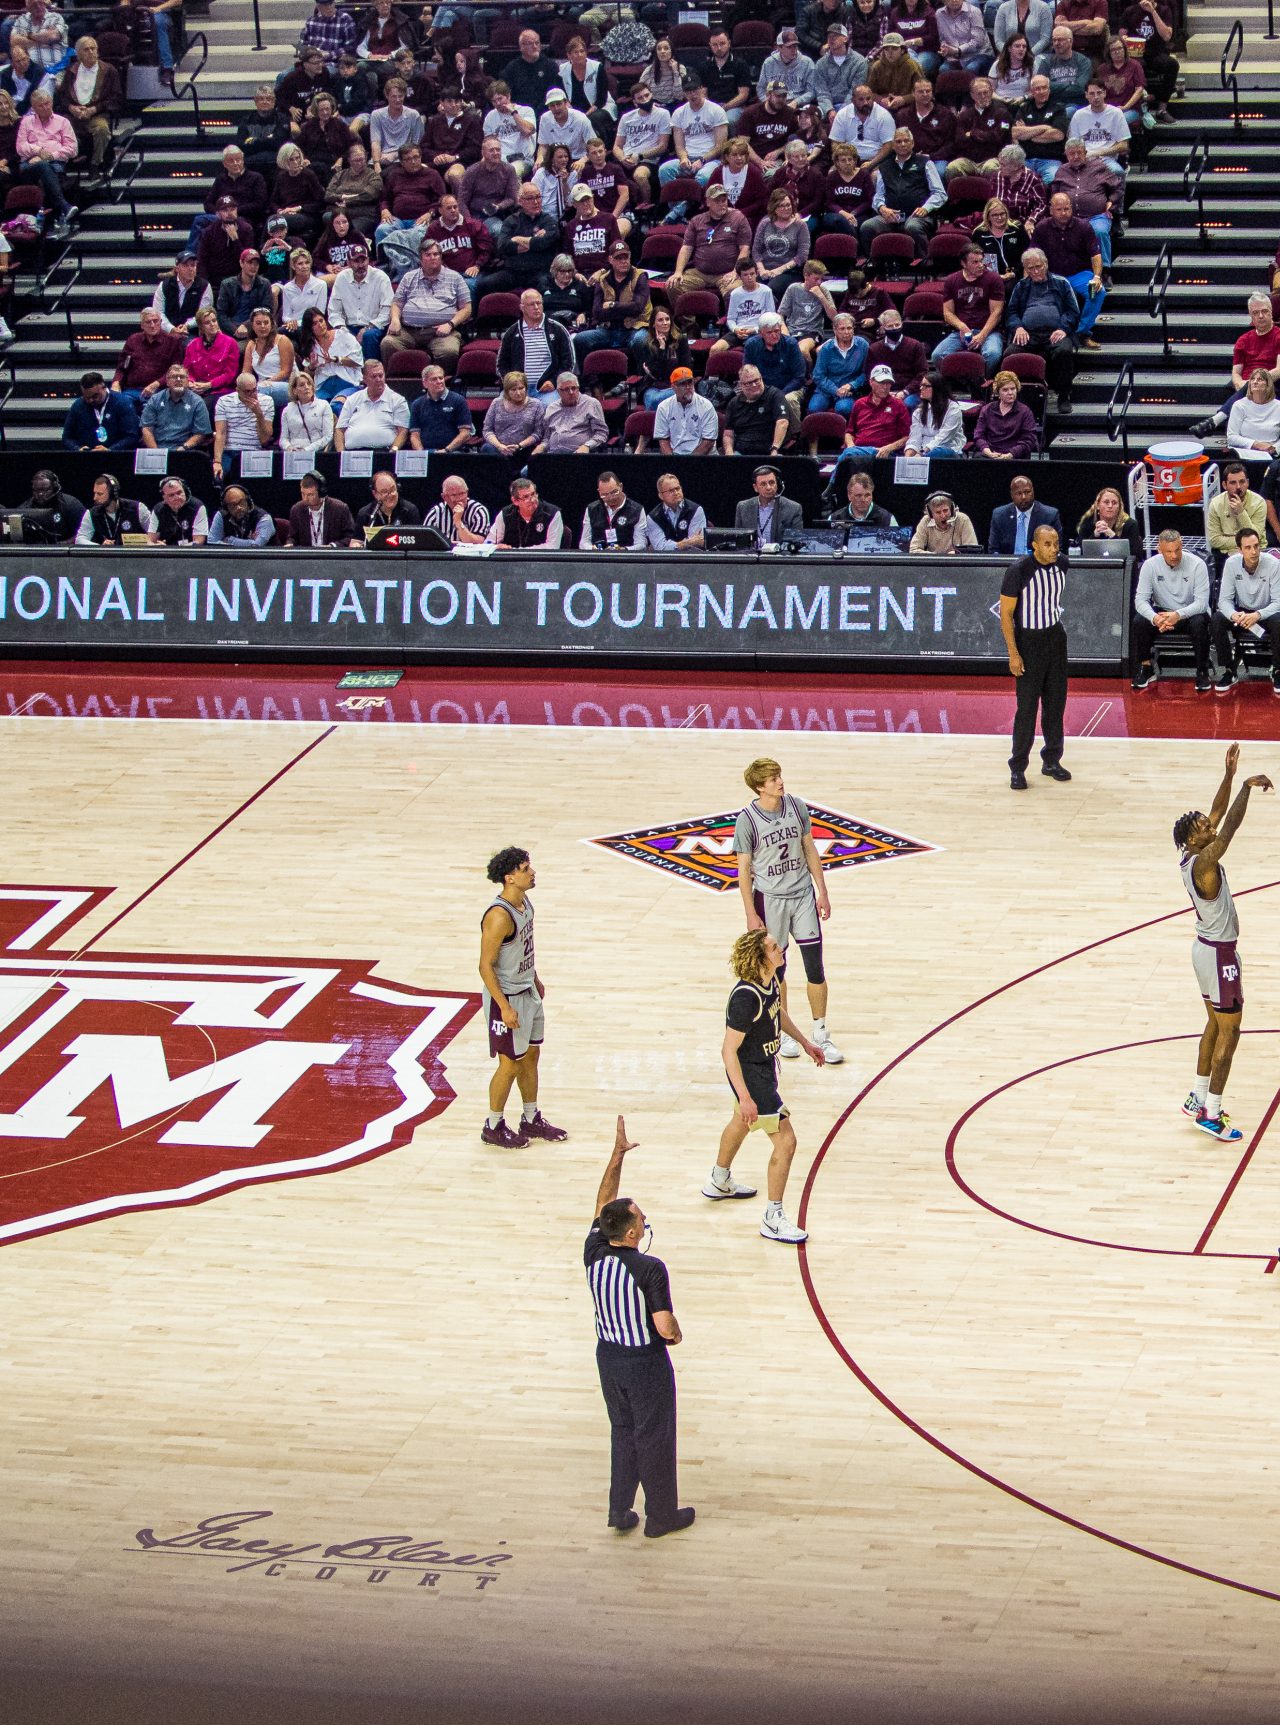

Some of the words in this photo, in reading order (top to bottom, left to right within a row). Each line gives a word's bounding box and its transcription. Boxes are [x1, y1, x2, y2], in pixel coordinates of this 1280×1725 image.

[835, 185, 863, 196] AGGIES
[573, 228, 606, 243] AGGIE
[398, 535, 416, 545] POSS
[188, 577, 500, 626] INVITATION
[525, 580, 957, 632] TOURNAMENT
[624, 814, 737, 841] NATION
[762, 826, 798, 848] TEXAS
[808, 808, 907, 847] NVITATION
[779, 844, 789, 859] 2
[613, 843, 720, 886] TOURNAMENT
[767, 859, 801, 878] AGGIES
[763, 1039, 781, 1057] FOR
[265, 1563, 502, 1589] COURT
